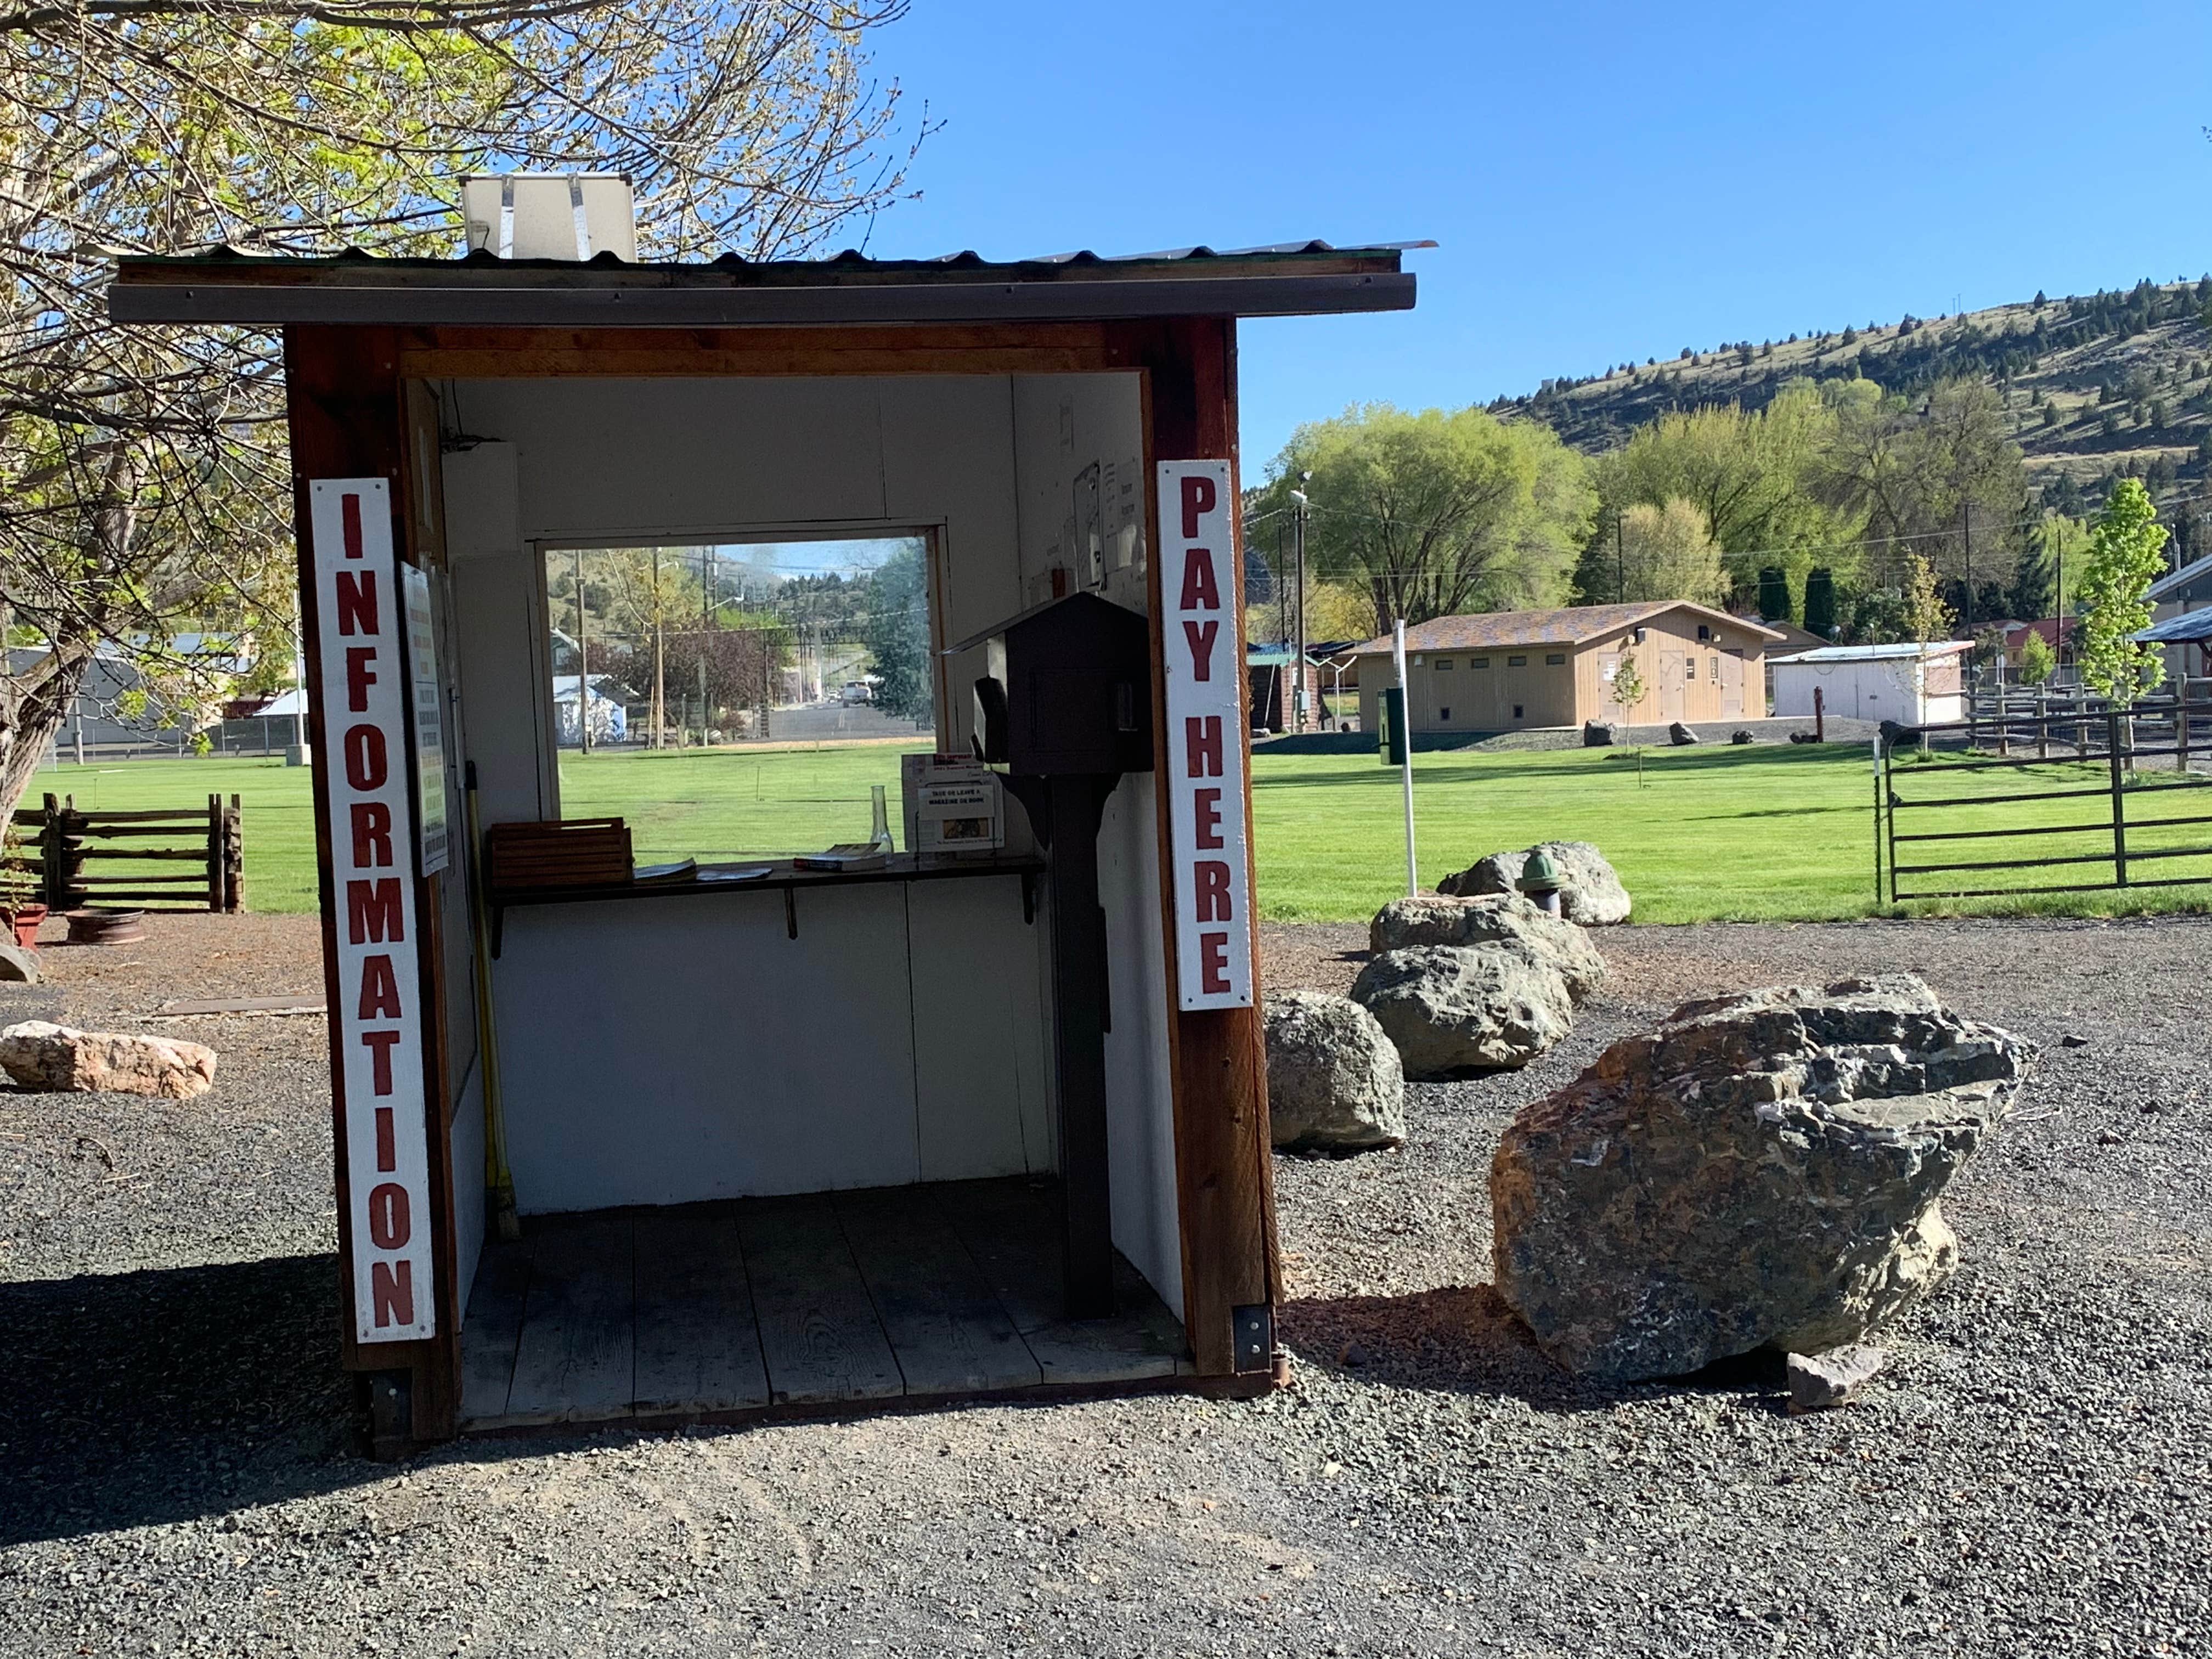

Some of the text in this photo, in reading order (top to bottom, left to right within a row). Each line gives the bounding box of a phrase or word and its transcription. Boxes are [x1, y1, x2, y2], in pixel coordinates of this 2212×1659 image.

[336, 493, 414, 1328] INFORMATION
[1180, 476, 1232, 995] PAY HERE
